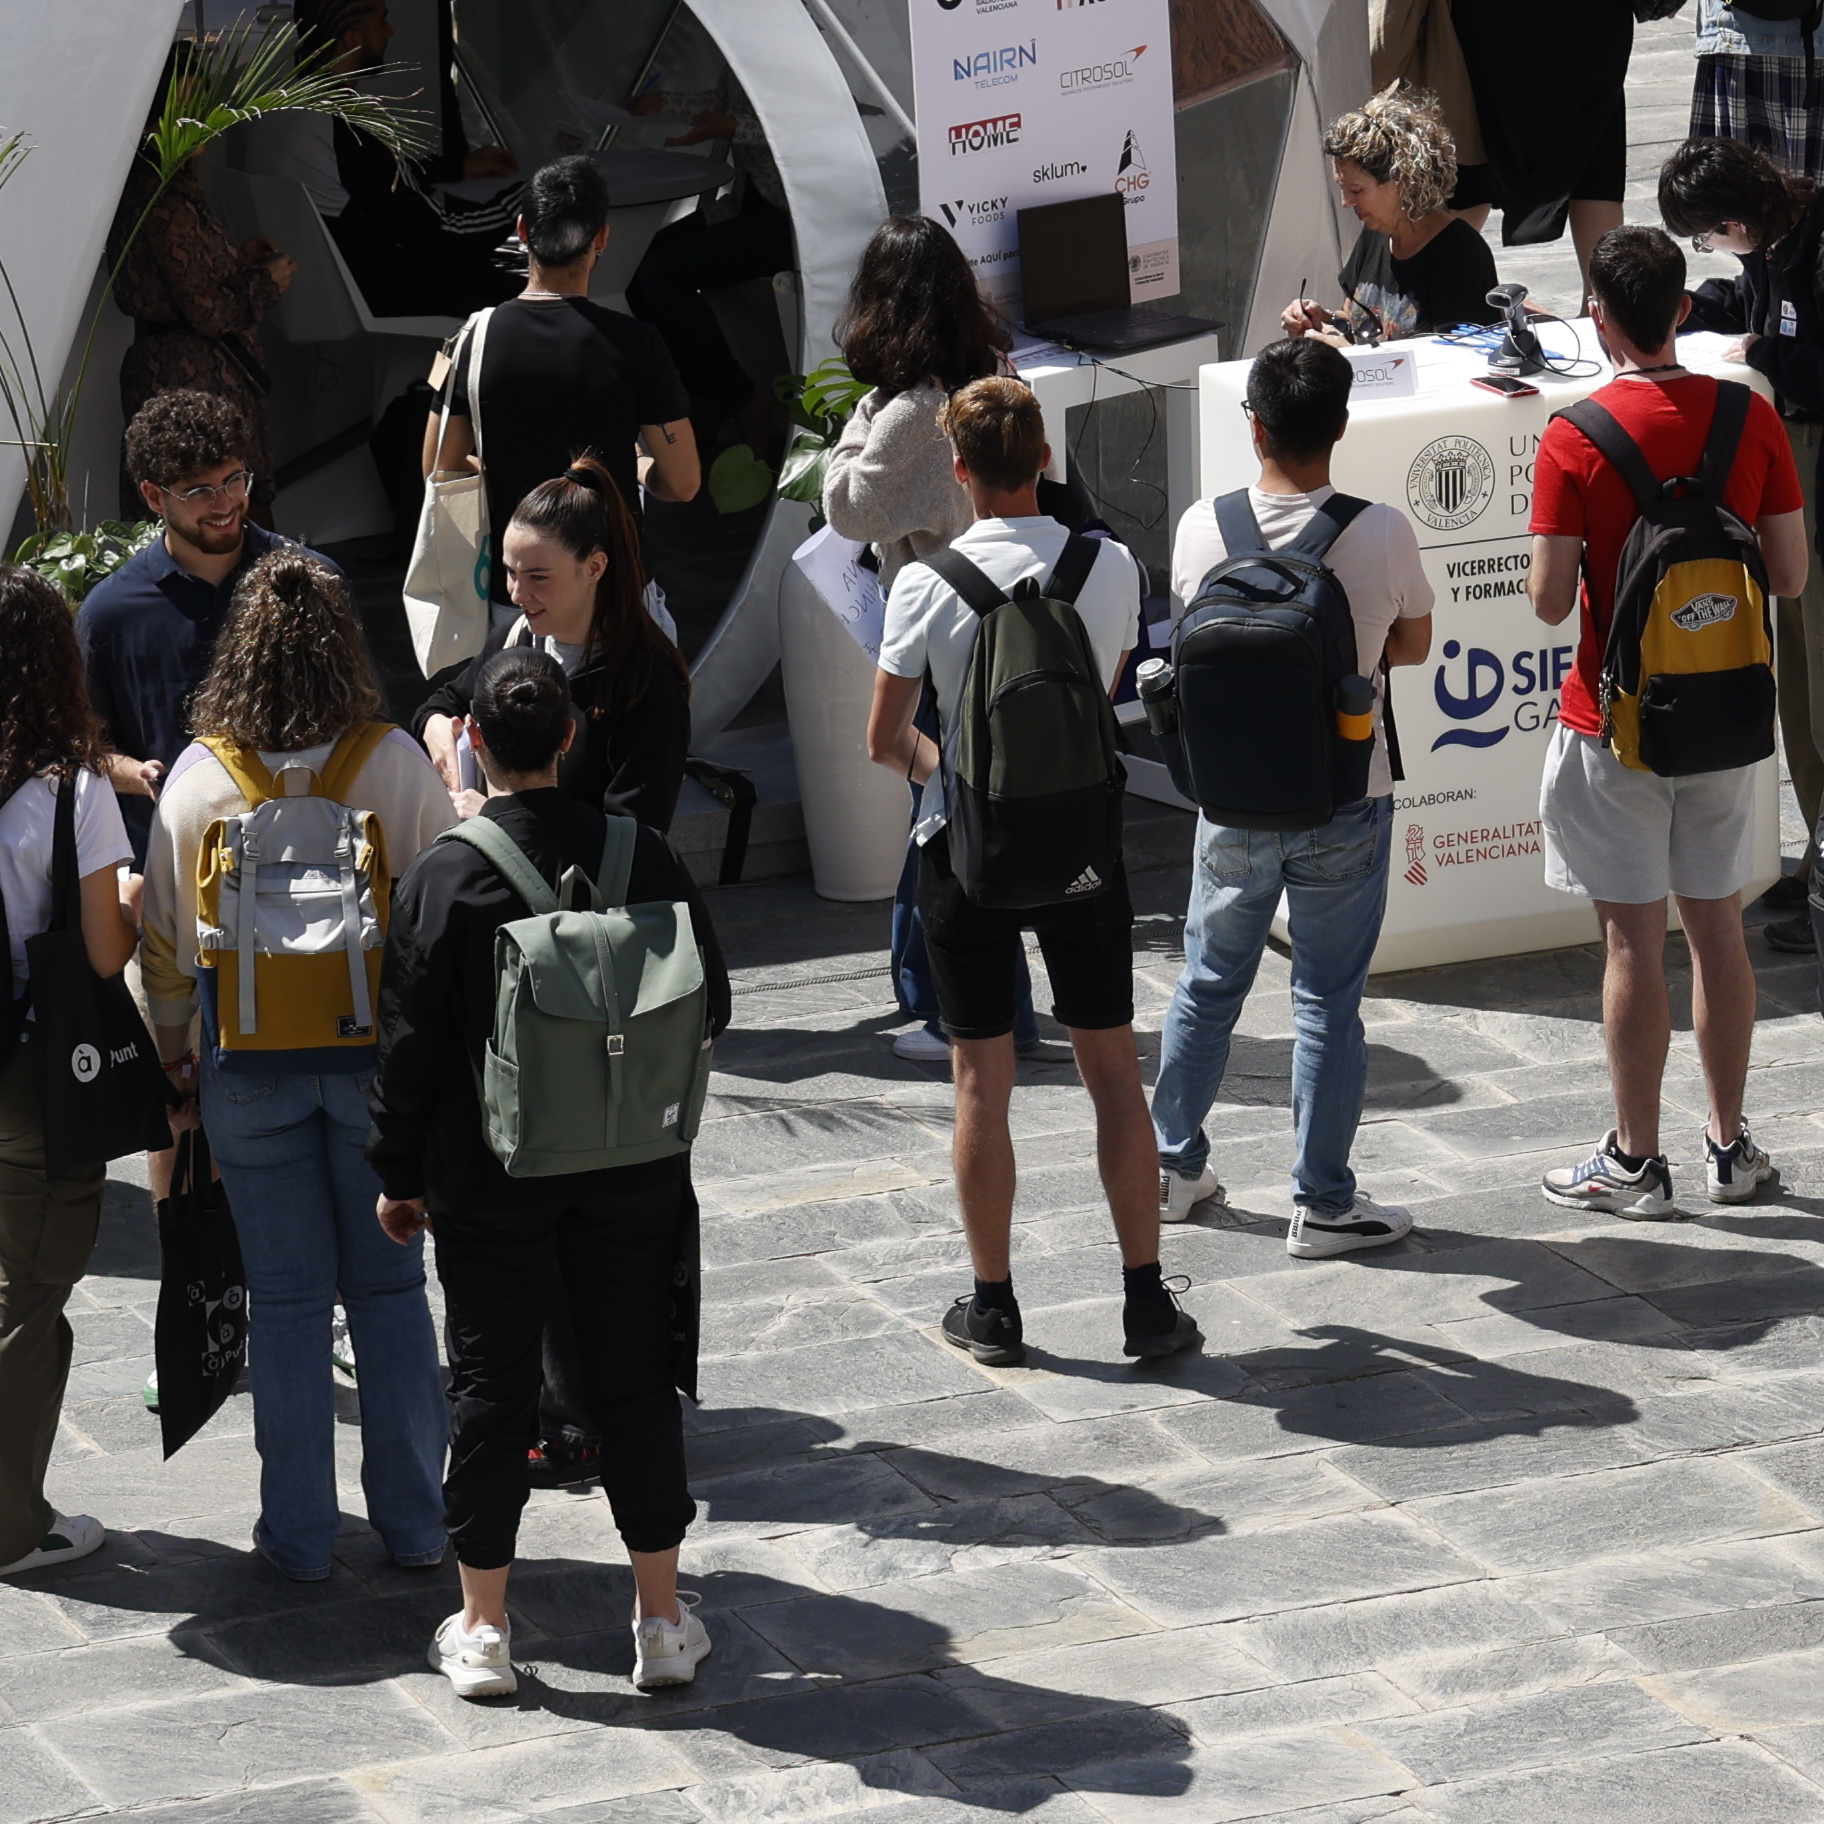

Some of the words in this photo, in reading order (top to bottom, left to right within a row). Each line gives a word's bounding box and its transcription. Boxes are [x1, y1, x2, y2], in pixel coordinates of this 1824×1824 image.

[976, 1, 1018, 14] VALENCIANA
[953, 40, 1036, 81] NAIRN
[974, 74, 1018, 89] TELECOM
[1060, 60, 1133, 89] CITROSOL
[951, 117, 1019, 156] HOME
[1033, 161, 1080, 184] sklum
[1115, 172, 1150, 194] CHG
[968, 196, 1008, 215] VICKY
[972, 212, 1005, 226] FOODS
[1352, 368, 1393, 383] OSOL
[1446, 553, 1532, 579] VICERRECTO
[1451, 586, 1461, 603] Y
[1465, 578, 1528, 602] FORMACI
[1691, 597, 1714, 612] VANS
[1696, 606, 1713, 620] THE
[1511, 645, 1573, 696] SIE
[1393, 788, 1476, 810] COLABORAN:
[1433, 820, 1542, 849] GENERALITAT
[1435, 840, 1541, 867] VALENCIANA
[1065, 878, 1102, 894] adidas
